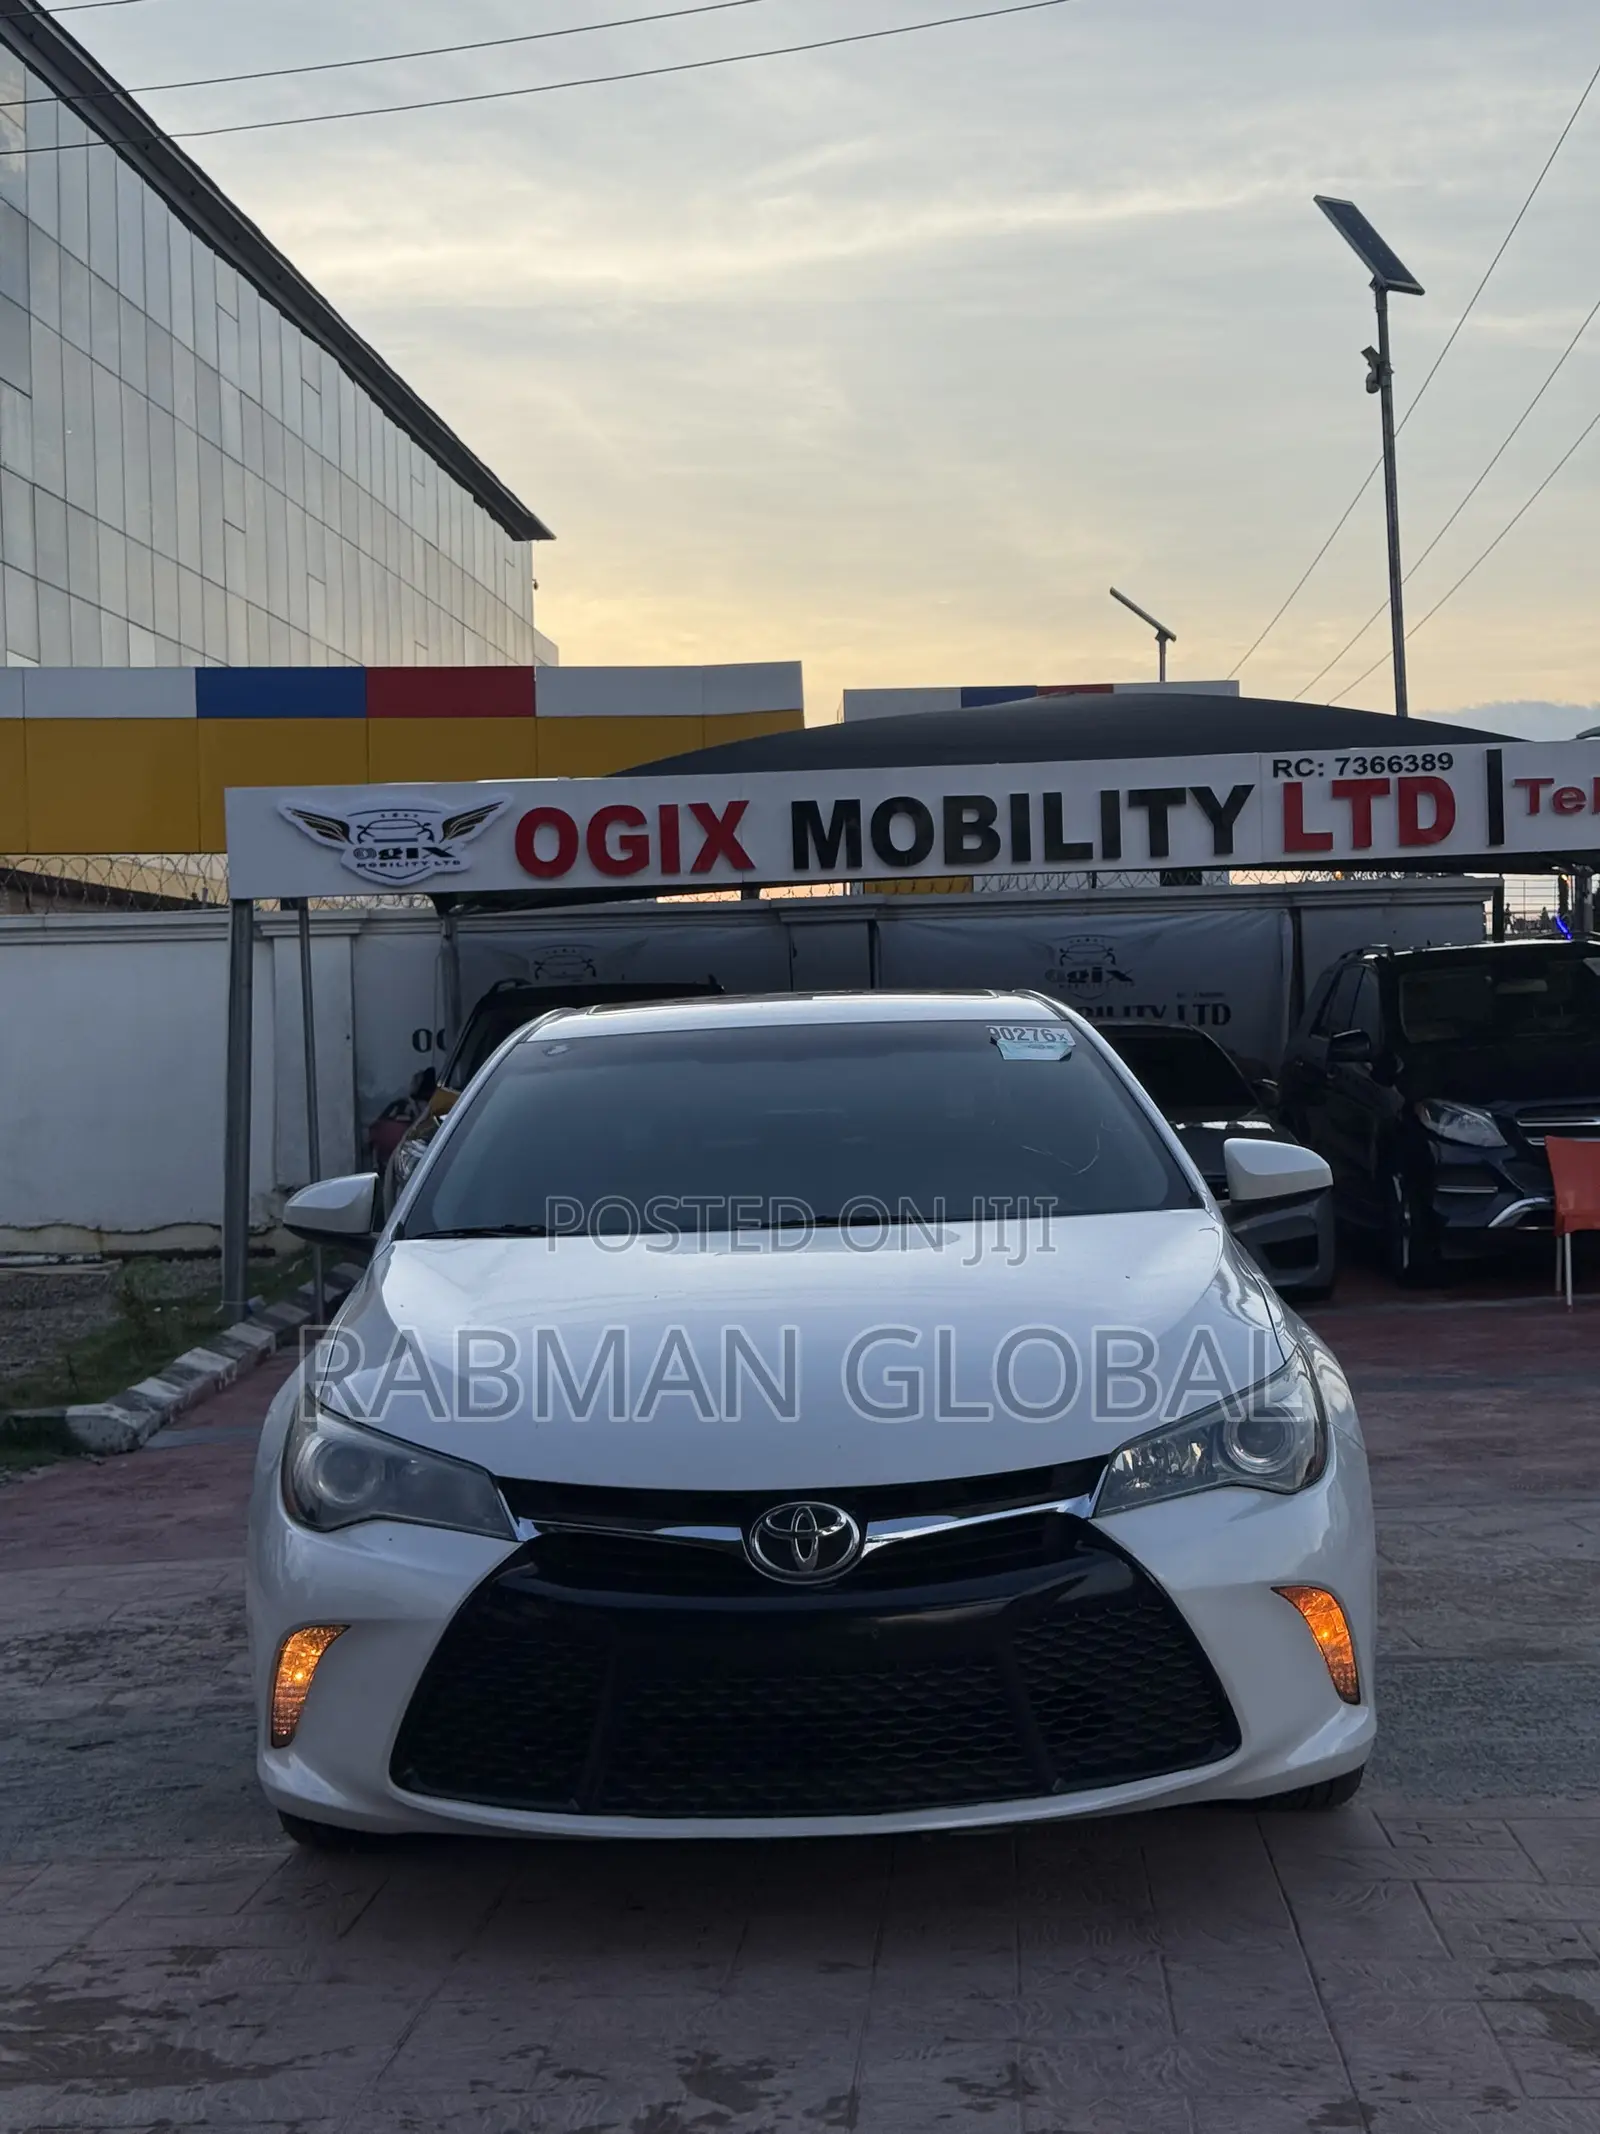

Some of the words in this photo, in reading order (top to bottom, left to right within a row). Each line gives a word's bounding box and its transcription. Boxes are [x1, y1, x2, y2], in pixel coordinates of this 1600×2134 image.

[1273, 757, 1324, 778] RC:
[1335, 751, 1455, 776] 7366389
[514, 799, 756, 880] OGIX
[790, 784, 1256, 872] MOBILITY
[1282, 776, 1456, 853] LTD
